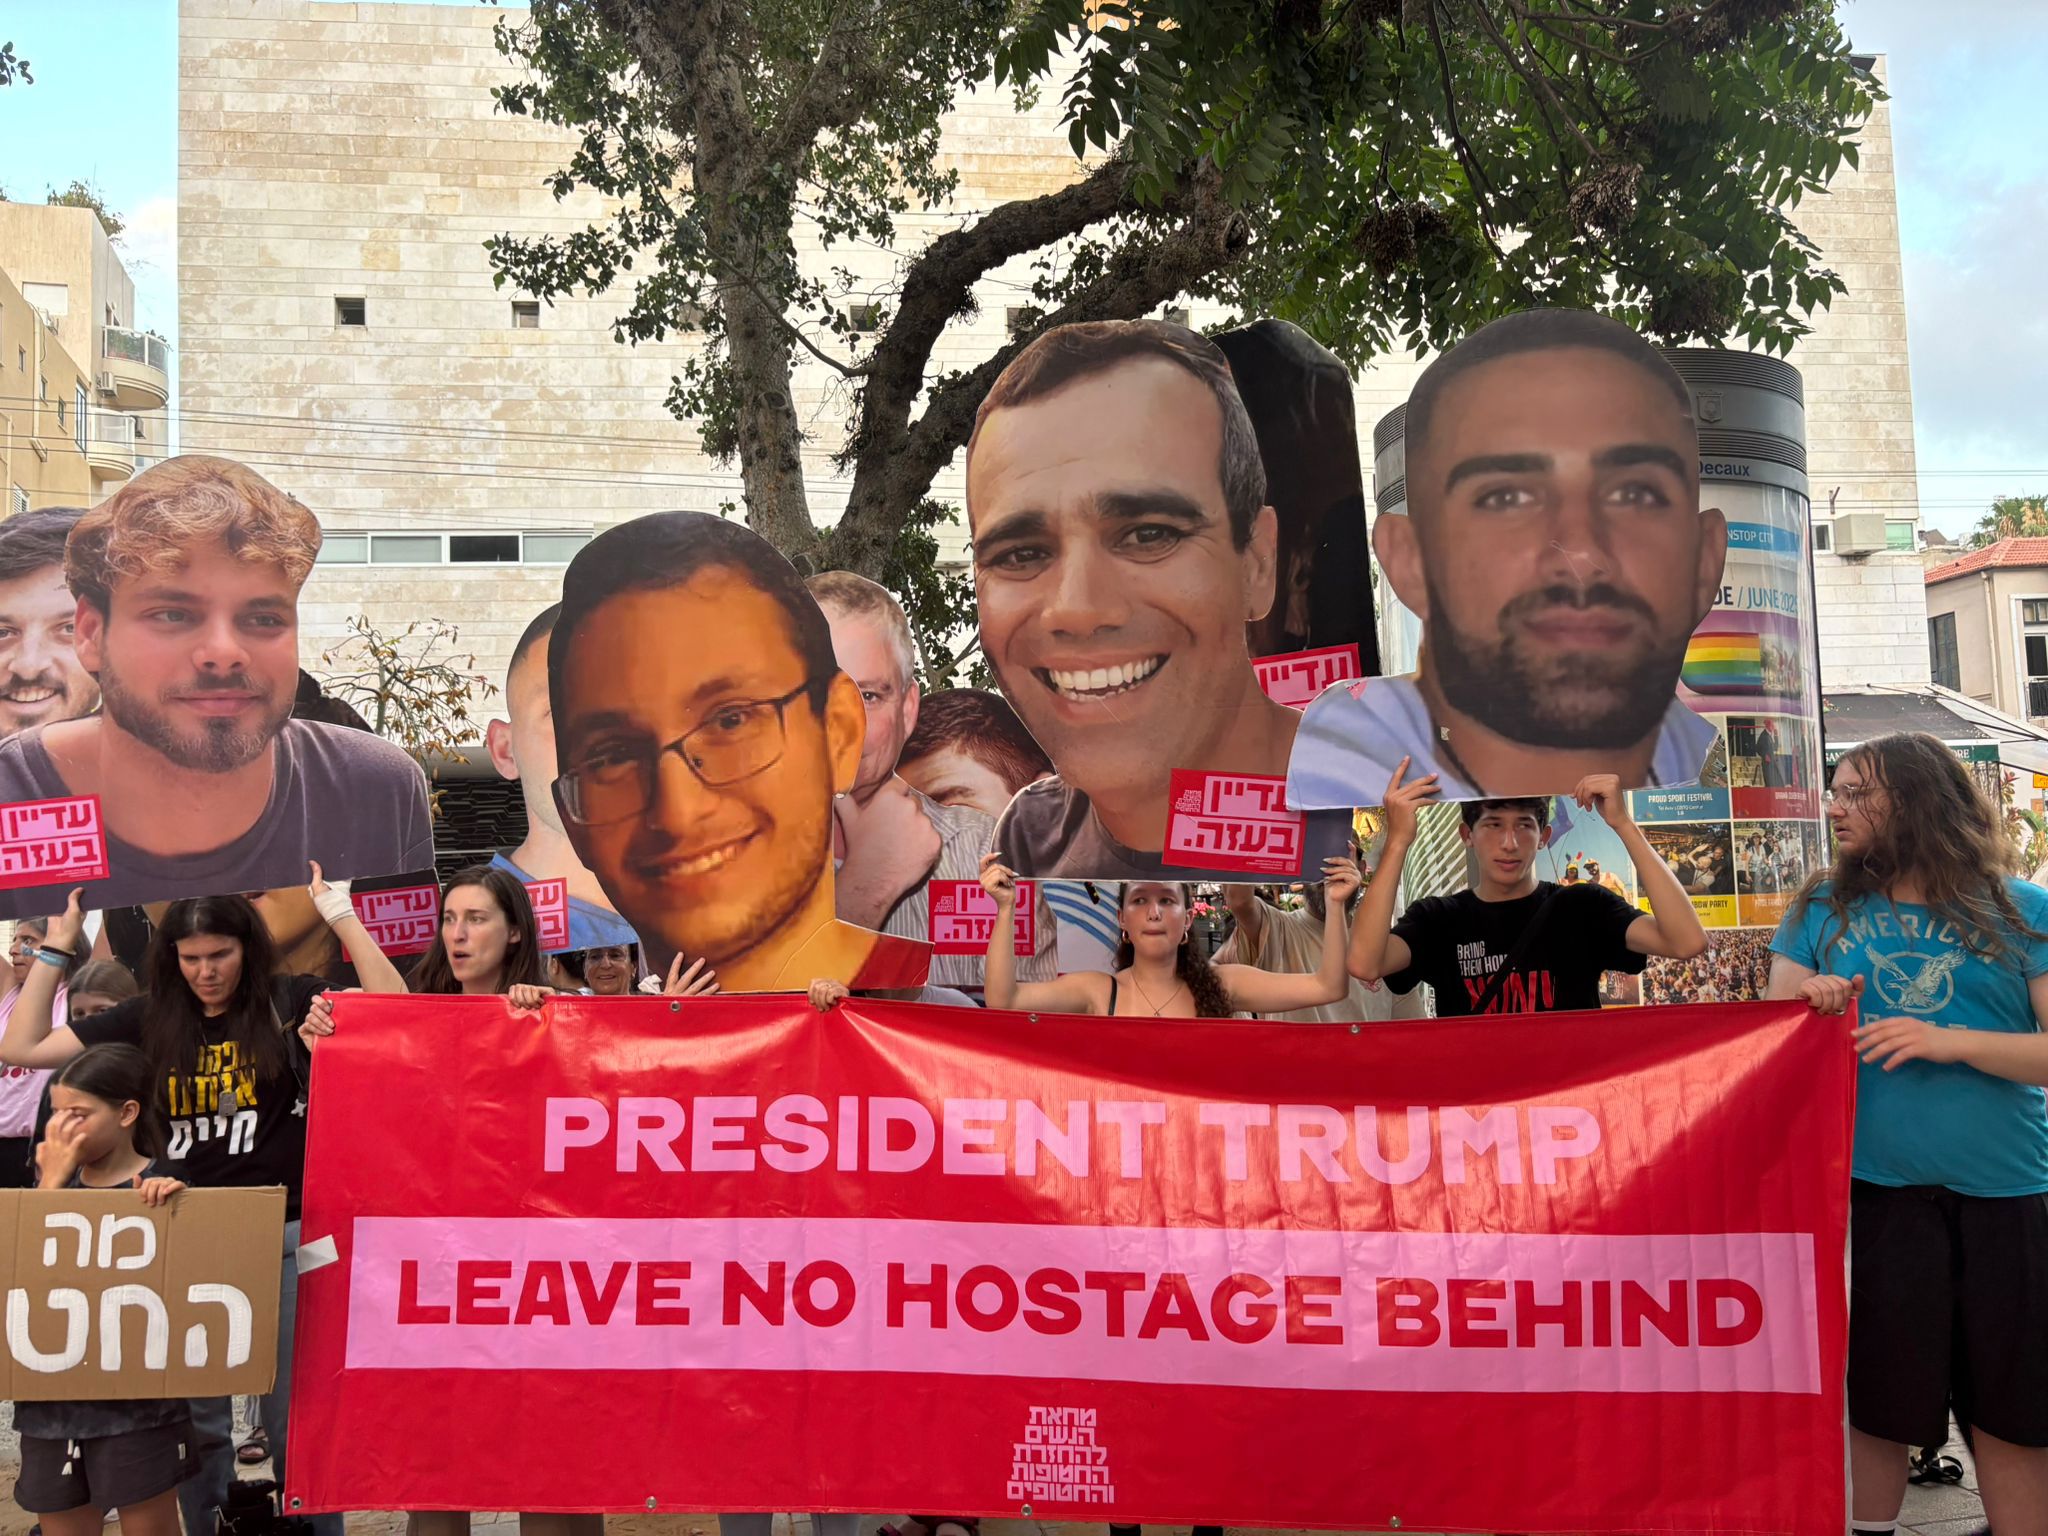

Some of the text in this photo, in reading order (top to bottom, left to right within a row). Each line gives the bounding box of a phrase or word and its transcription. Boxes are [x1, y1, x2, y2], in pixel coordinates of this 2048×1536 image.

[1699, 461, 1750, 477] ecaux
[1747, 587, 1779, 610] JUNE
[1668, 794, 1686, 803] SPORT
[9, 803, 91, 838] עדיין
[1183, 821, 1295, 855] בעזה.
[2, 838, 98, 871] בעזה
[368, 891, 432, 920] עדיין
[1457, 941, 1485, 960] BRING
[167, 1110, 258, 1160] חיים
[544, 1094, 1601, 1185] PRESIDENT TRUMP
[43, 1212, 157, 1270] מה
[397, 1259, 1763, 1348] LEAVE NO HOSTAGE BEHIND
[6, 1283, 253, 1373] החט
[1029, 1405, 1097, 1427] מחאת
[1025, 1424, 1095, 1446] הנשים
[1013, 1443, 1108, 1466] להחזרת
[1011, 1461, 1109, 1485] החטופות
[1006, 1479, 1115, 1504] והחטופים
